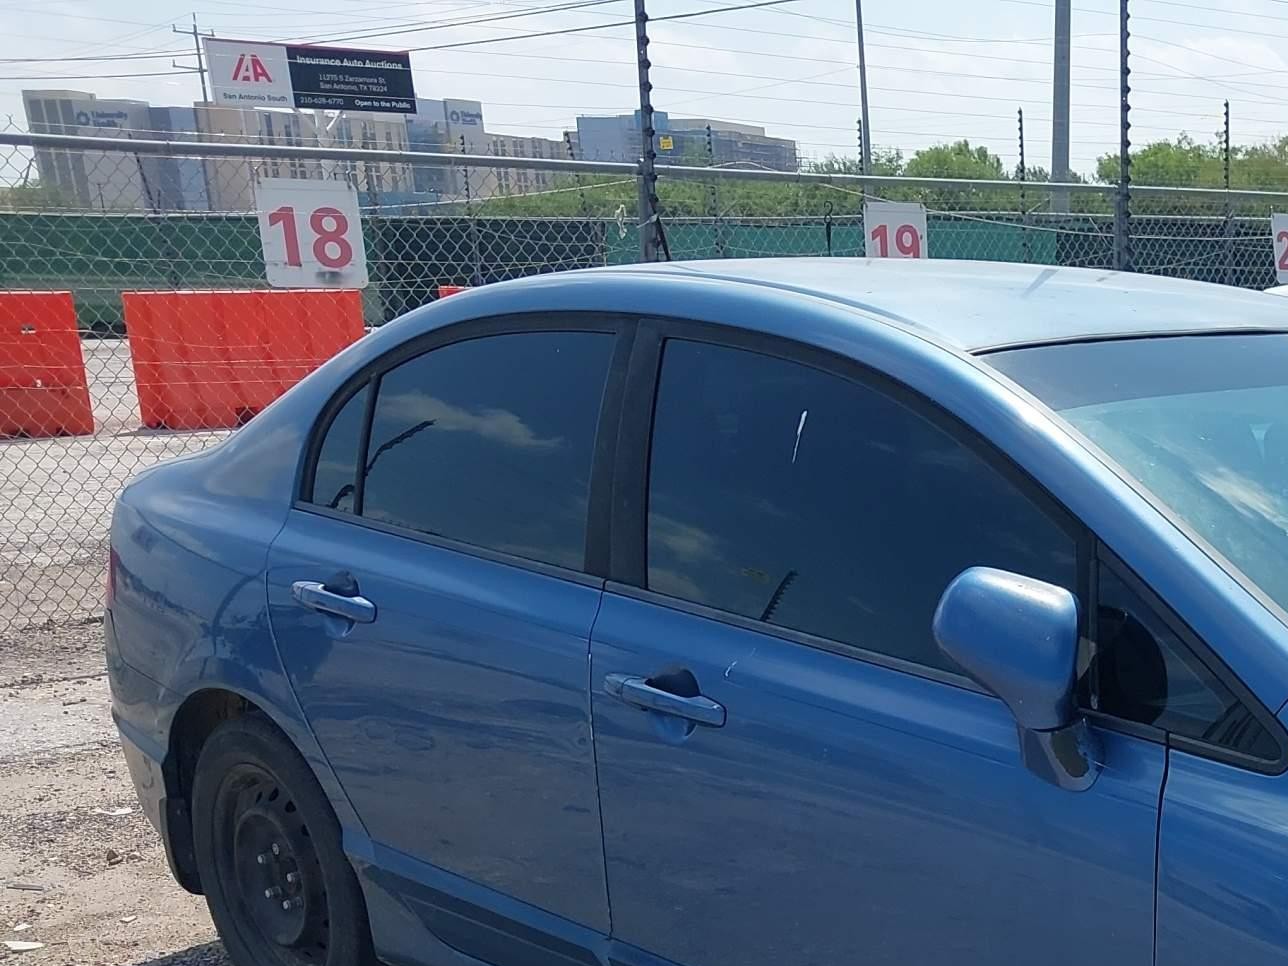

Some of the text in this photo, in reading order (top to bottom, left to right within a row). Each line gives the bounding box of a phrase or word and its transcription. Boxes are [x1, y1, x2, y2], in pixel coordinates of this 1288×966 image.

[296, 55, 403, 69] Insurance Auto Auctions
[223, 92, 288, 102] San Antonio South
[354, 99, 372, 107] Open
[391, 100, 411, 109] Public
[268, 206, 353, 268] 18
[871, 224, 920, 258] 19
